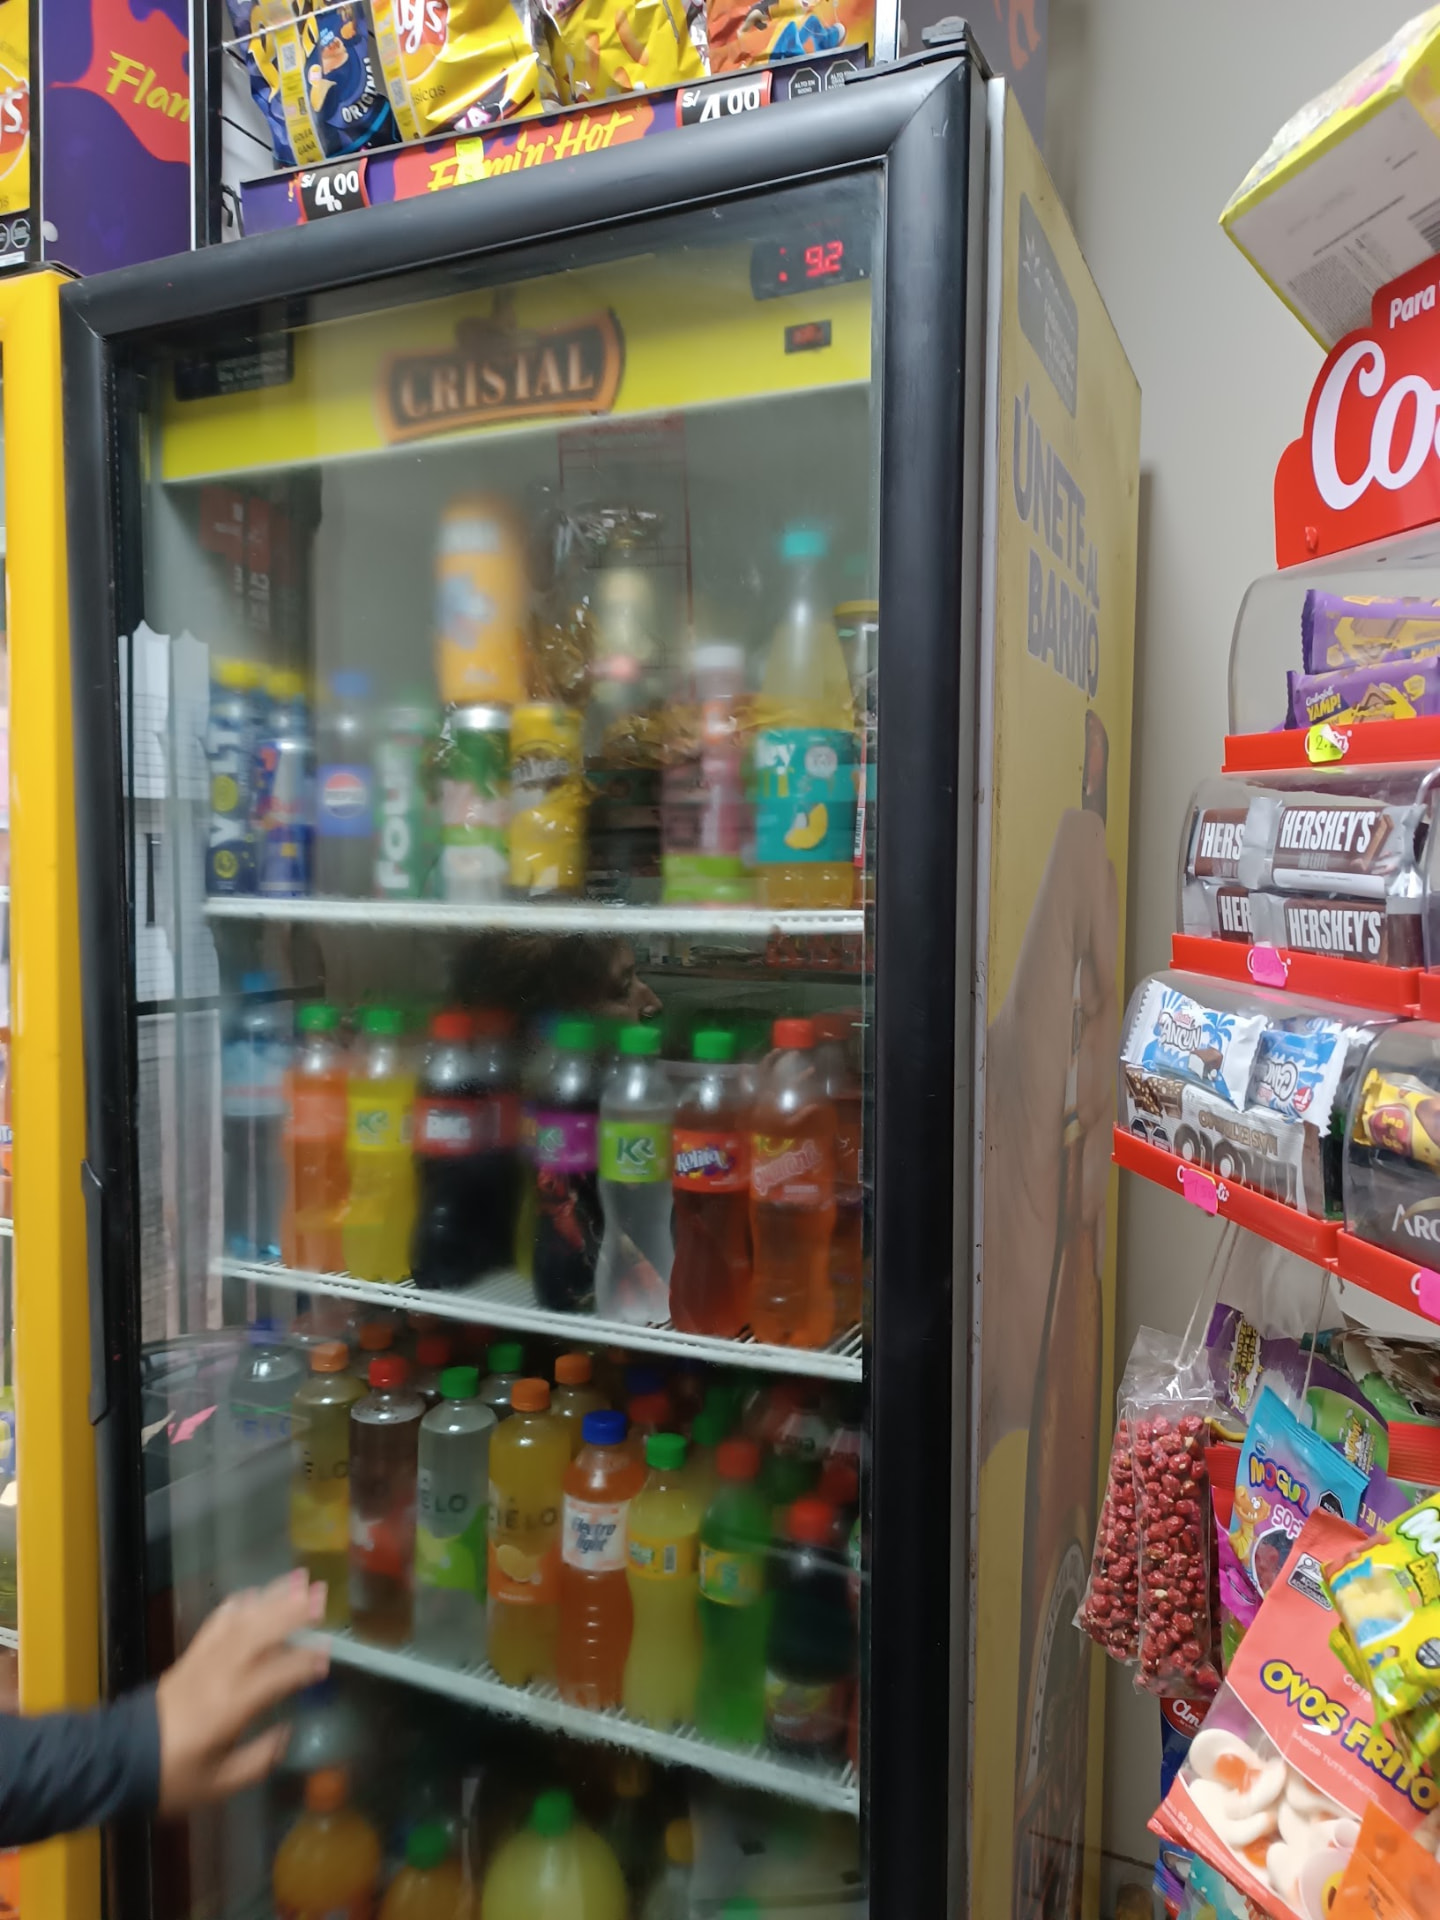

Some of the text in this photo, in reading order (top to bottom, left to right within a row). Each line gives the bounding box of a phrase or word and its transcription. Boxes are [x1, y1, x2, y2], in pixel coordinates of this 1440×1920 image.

[553, 109, 634, 161] Hot
[1389, 284, 1435, 329] Para
[1312, 339, 1440, 511] Co
[1027, 547, 1099, 698] BARRIO
[1307, 692, 1342, 722] YAMP!
[1200, 822, 1246, 860] HERS
[1279, 810, 1375, 853] HERSHEY'S
[1220, 895, 1251, 932] HER
[1288, 908, 1381, 954] HERSHEY'S
[1250, 1453, 1311, 1518] MOGUL
[1271, 1503, 1304, 1540] SOF
[1261, 1660, 1349, 1735] OVOS
